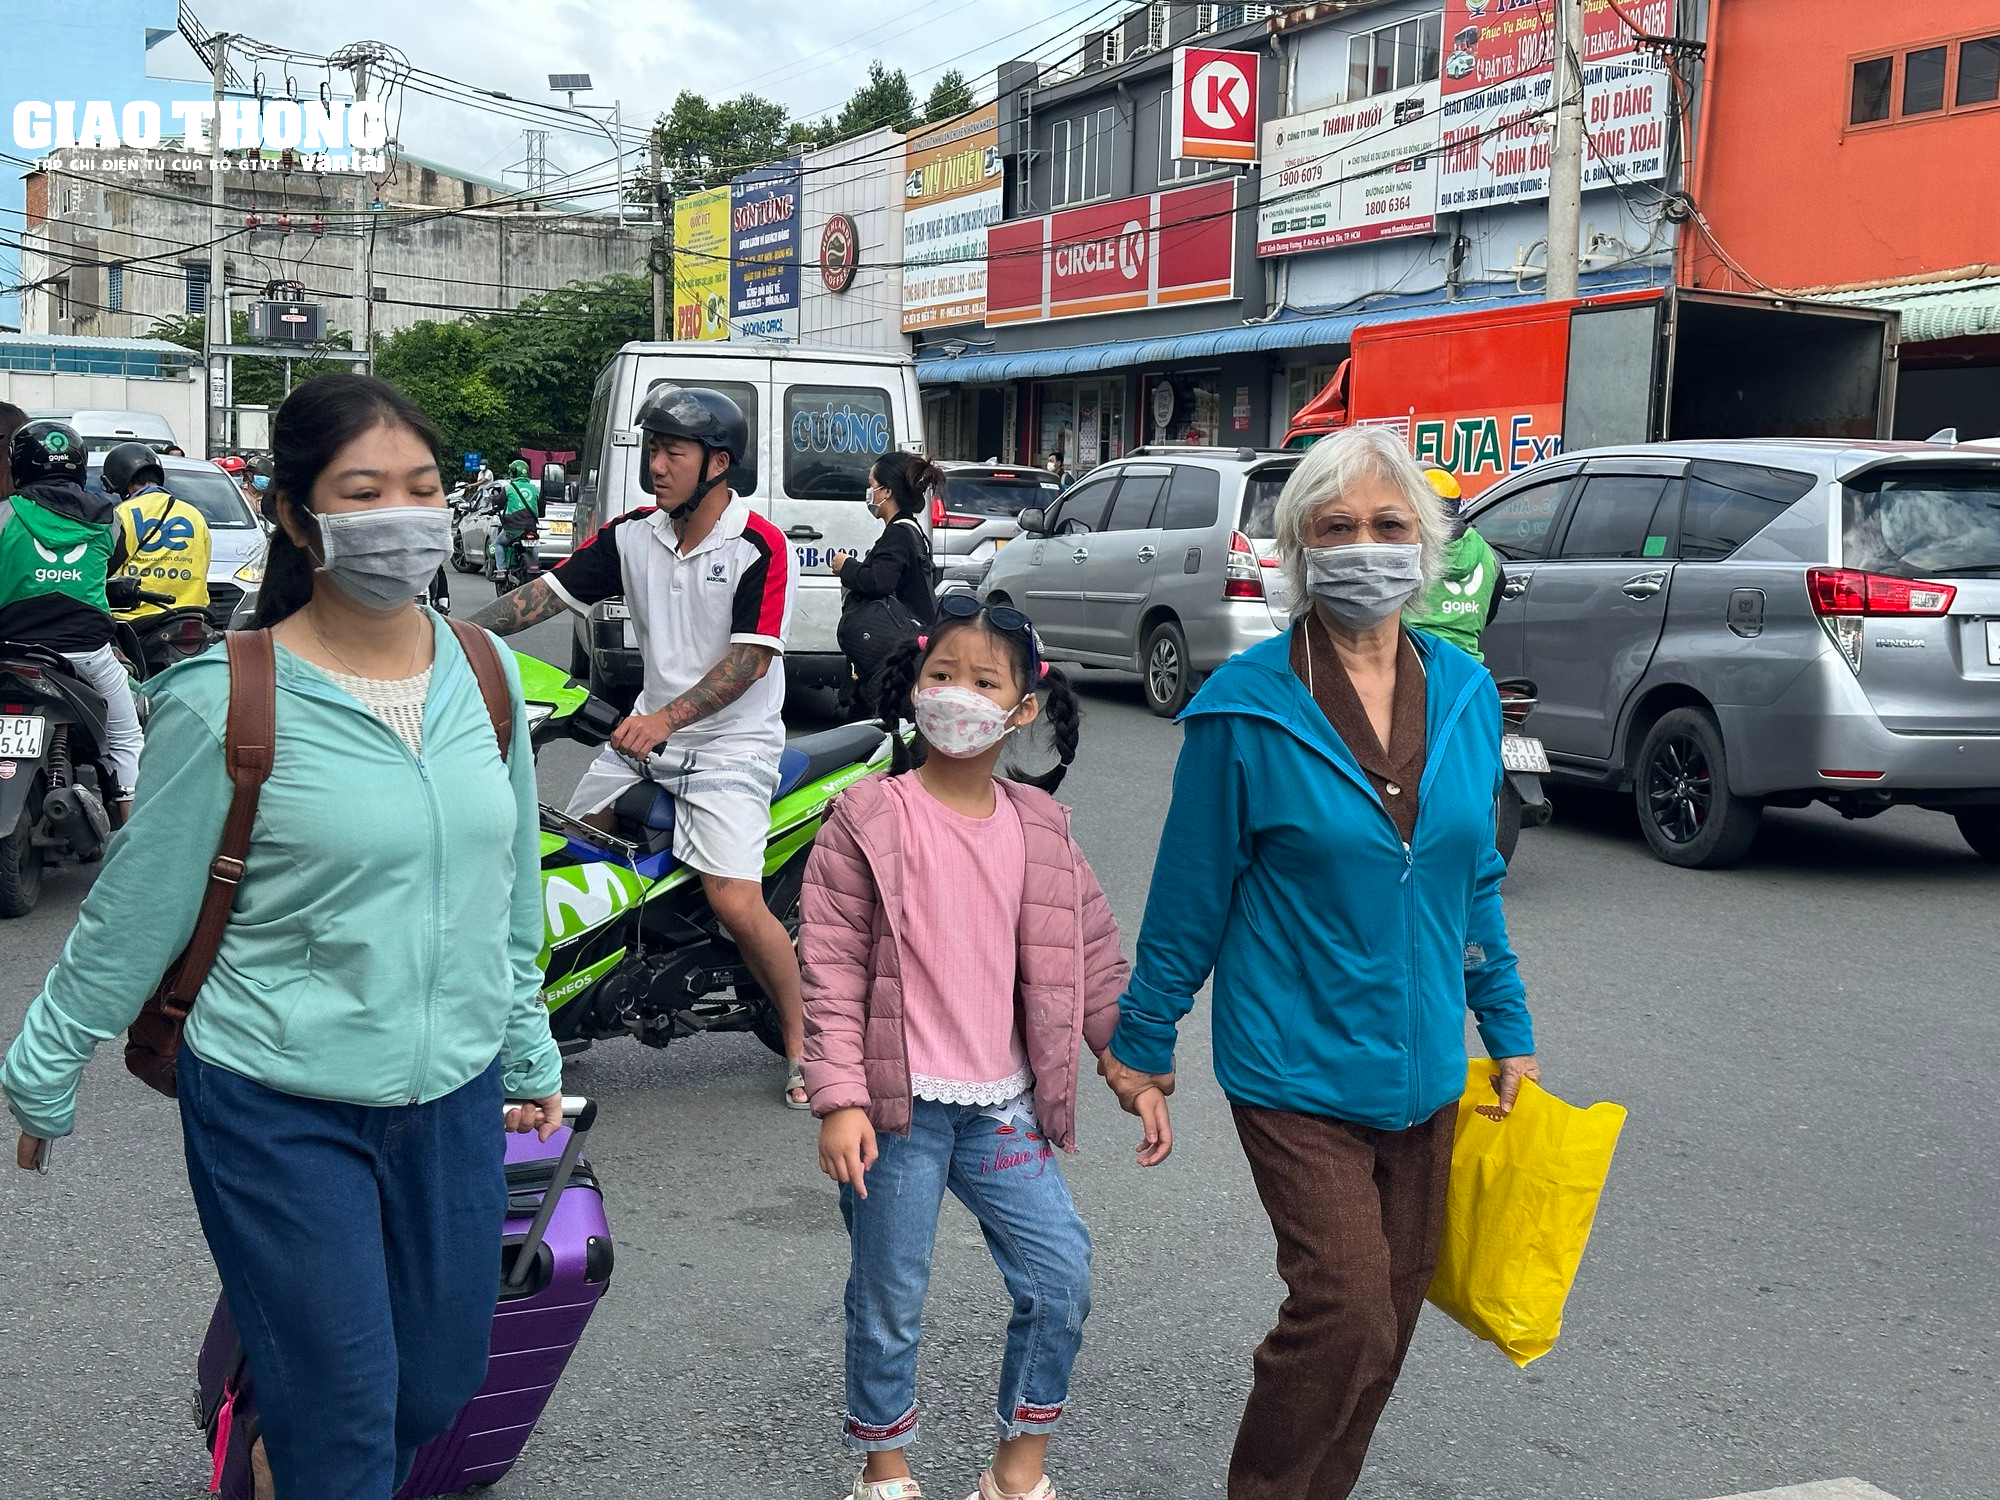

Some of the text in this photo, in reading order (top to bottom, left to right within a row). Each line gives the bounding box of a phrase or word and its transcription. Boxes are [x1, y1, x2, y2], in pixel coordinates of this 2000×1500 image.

[1480, 27, 1501, 42] Phục
[1503, 21, 1513, 37] Vụ
[1485, 54, 1500, 85] ĐẶT
[1444, 99, 1461, 117] GIAO
[1487, 86, 1510, 108] HÀNG
[1510, 82, 1527, 102] HÓA
[1534, 79, 1552, 99] HỢP
[1591, 89, 1609, 124] BÙ
[1613, 83, 1653, 119] ĐĂNG
[1301, 130, 1306, 139] TY
[1323, 113, 1355, 138] THÀNH
[1357, 103, 1382, 130] BƯỞI
[1496, 145, 1526, 177] BÌNH
[1587, 123, 1625, 161] ĐỒNG
[1628, 116, 1662, 154] XOÀI
[923, 142, 985, 199] MỸ DUYÊN
[1279, 165, 1323, 187] 1900 6079
[1441, 193, 1452, 208] ĐỊA
[1632, 157, 1659, 174] TP.HCM
[734, 201, 758, 232] SƠN
[1365, 195, 1410, 216] 1800 6364
[823, 220, 851, 252] HIGHLANDS
[1055, 245, 1115, 277] CIRCLE
[743, 318, 783, 337] BOOKING OFFICE
[48, 454, 69, 462] gojek
[1415, 417, 1503, 474] FUTA
[131, 508, 194, 552] be
[35, 567, 82, 583] gojek
[1442, 600, 1479, 614] gojek
[1876, 639, 1925, 648] INNOVA
[1504, 739, 1536, 754] 59-T1
[1505, 754, 1546, 769] 133.58
[547, 974, 592, 1001] ENEOS
[995, 1137, 1033, 1171] love
